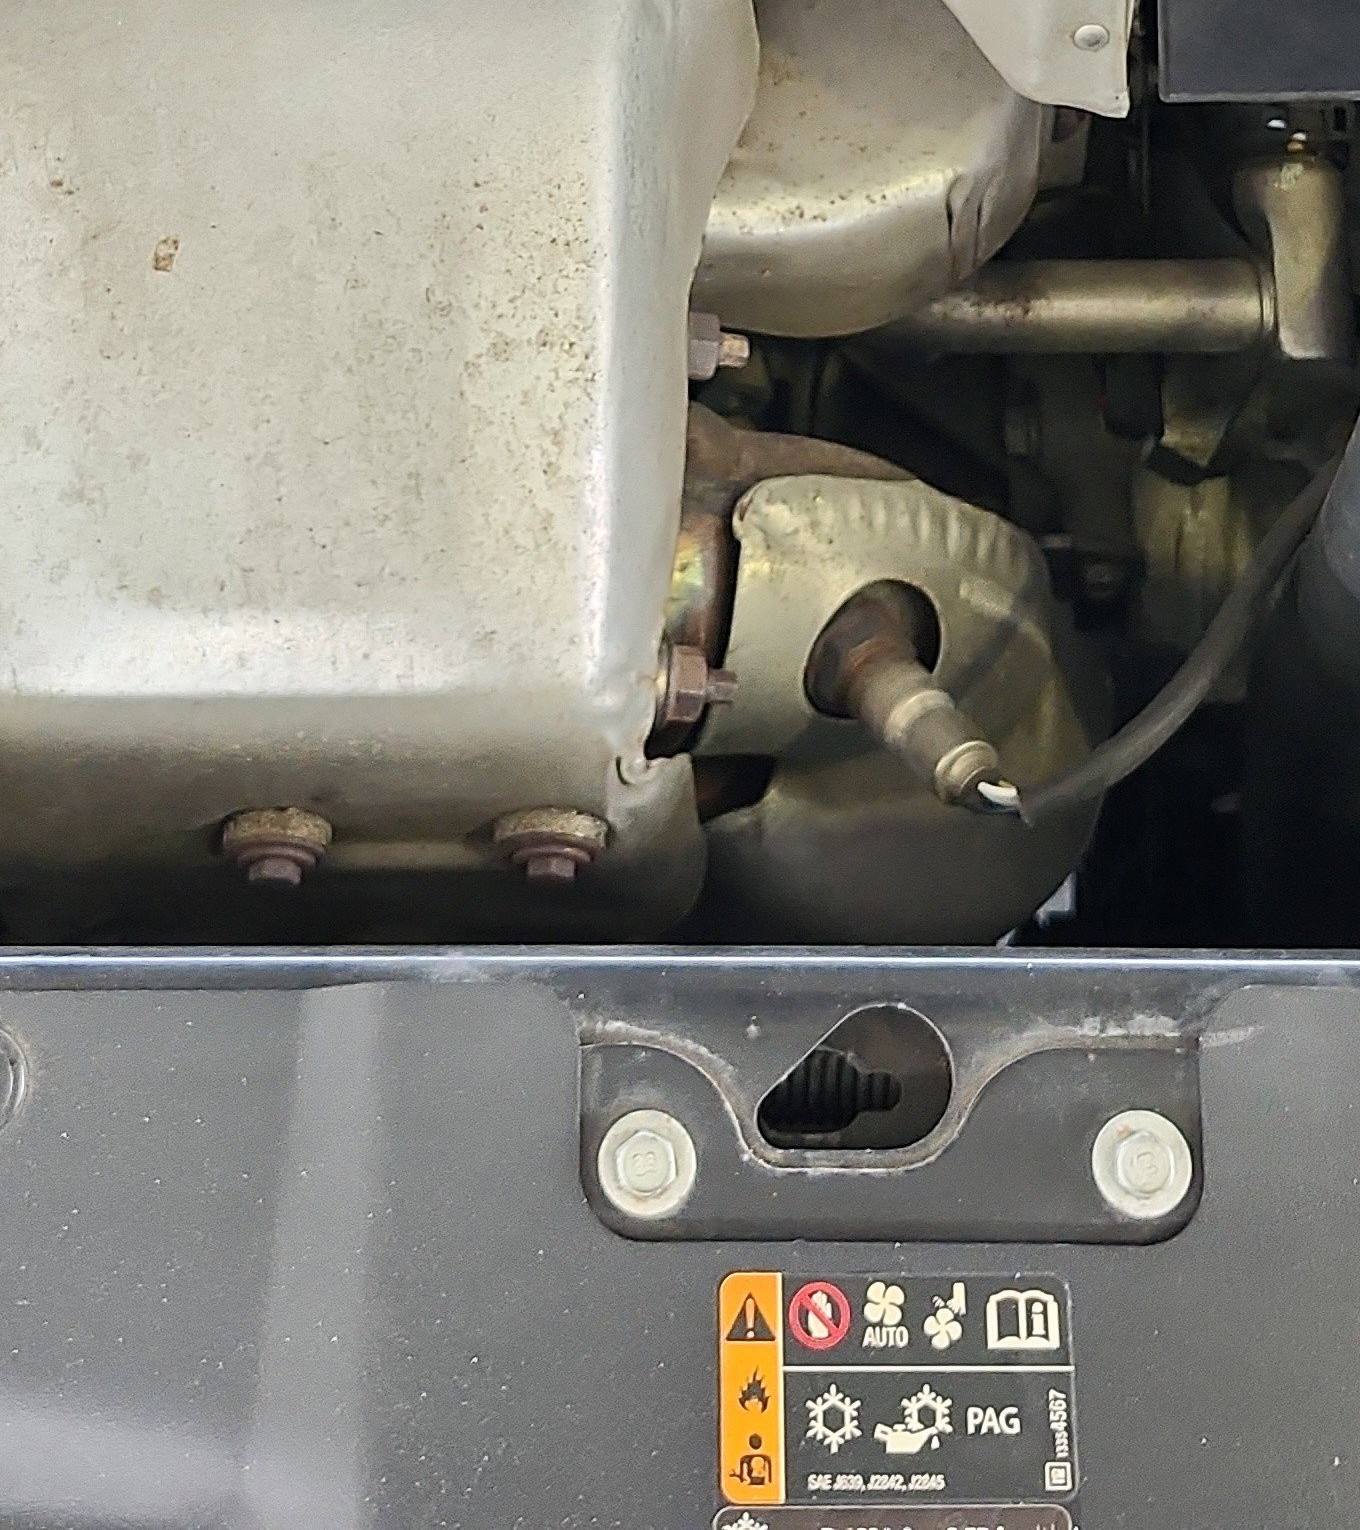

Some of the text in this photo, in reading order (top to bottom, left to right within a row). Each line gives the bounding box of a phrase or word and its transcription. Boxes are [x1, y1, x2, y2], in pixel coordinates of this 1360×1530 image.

[862, 1325, 909, 1348] AUTO
[966, 1407, 1021, 1435] PAG
[807, 1473, 833, 1491] SAE
